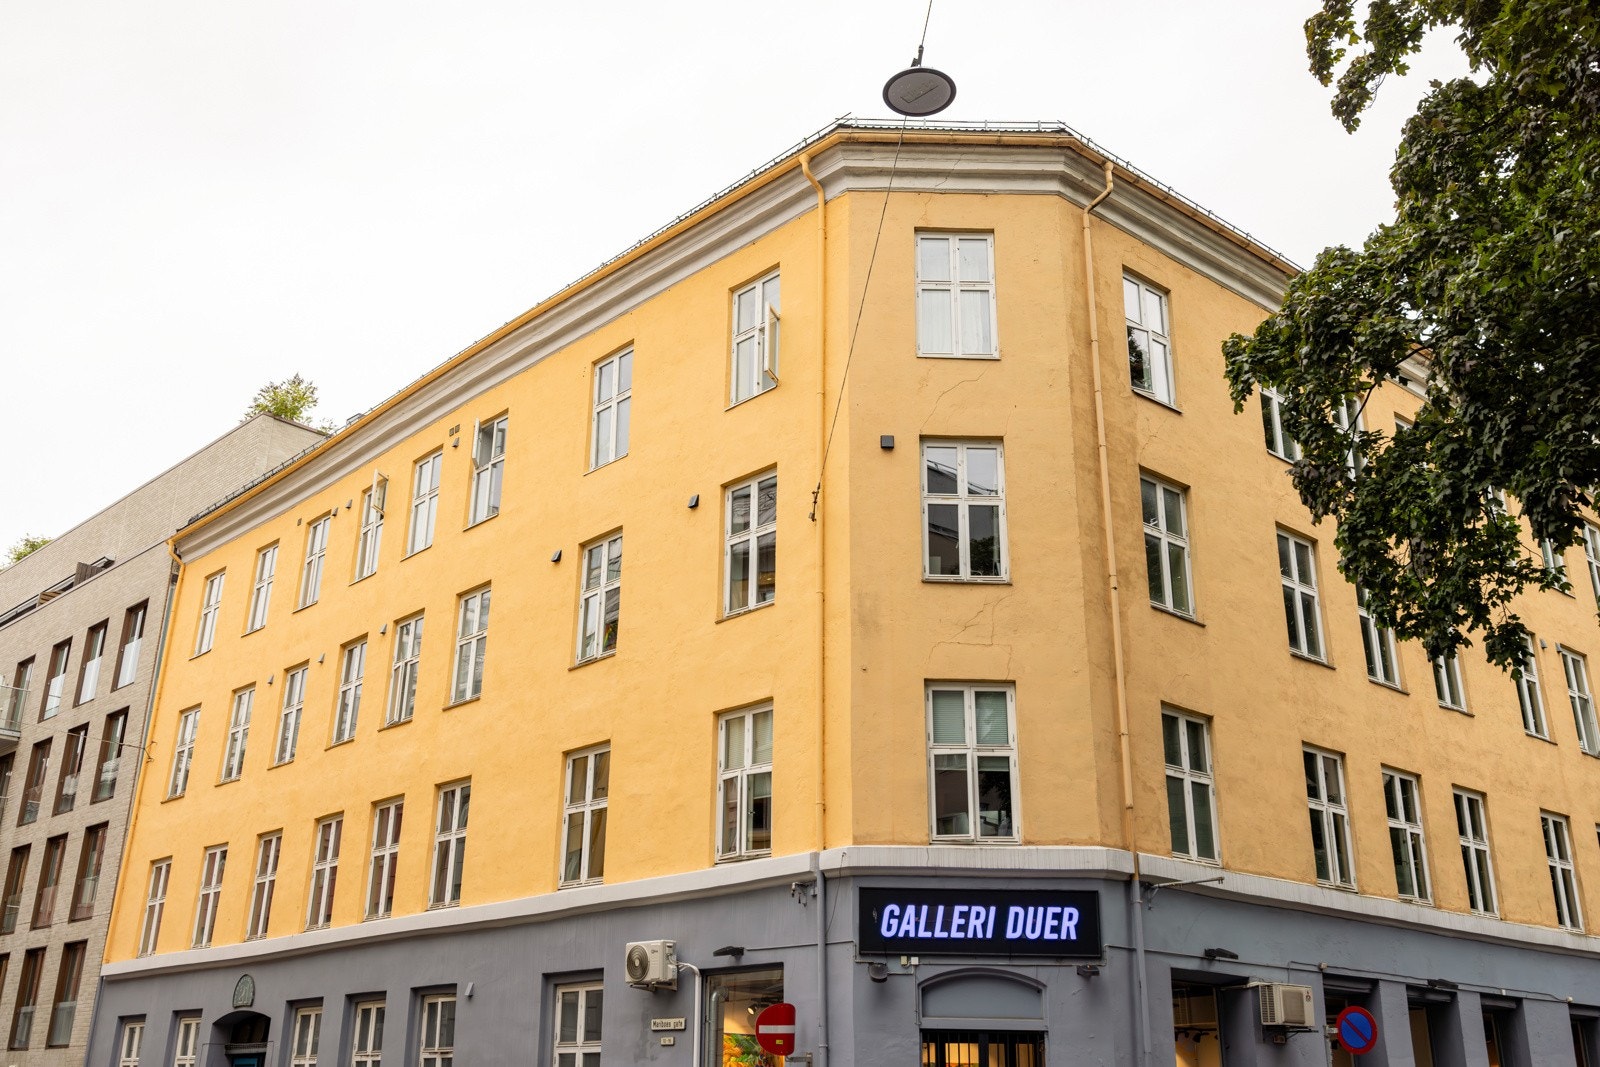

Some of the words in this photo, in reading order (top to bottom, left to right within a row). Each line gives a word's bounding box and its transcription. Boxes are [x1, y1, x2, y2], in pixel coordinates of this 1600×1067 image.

[880, 903, 997, 939] GALLERI
[1005, 905, 1080, 940] DUER
[673, 1020, 683, 1029] gate
